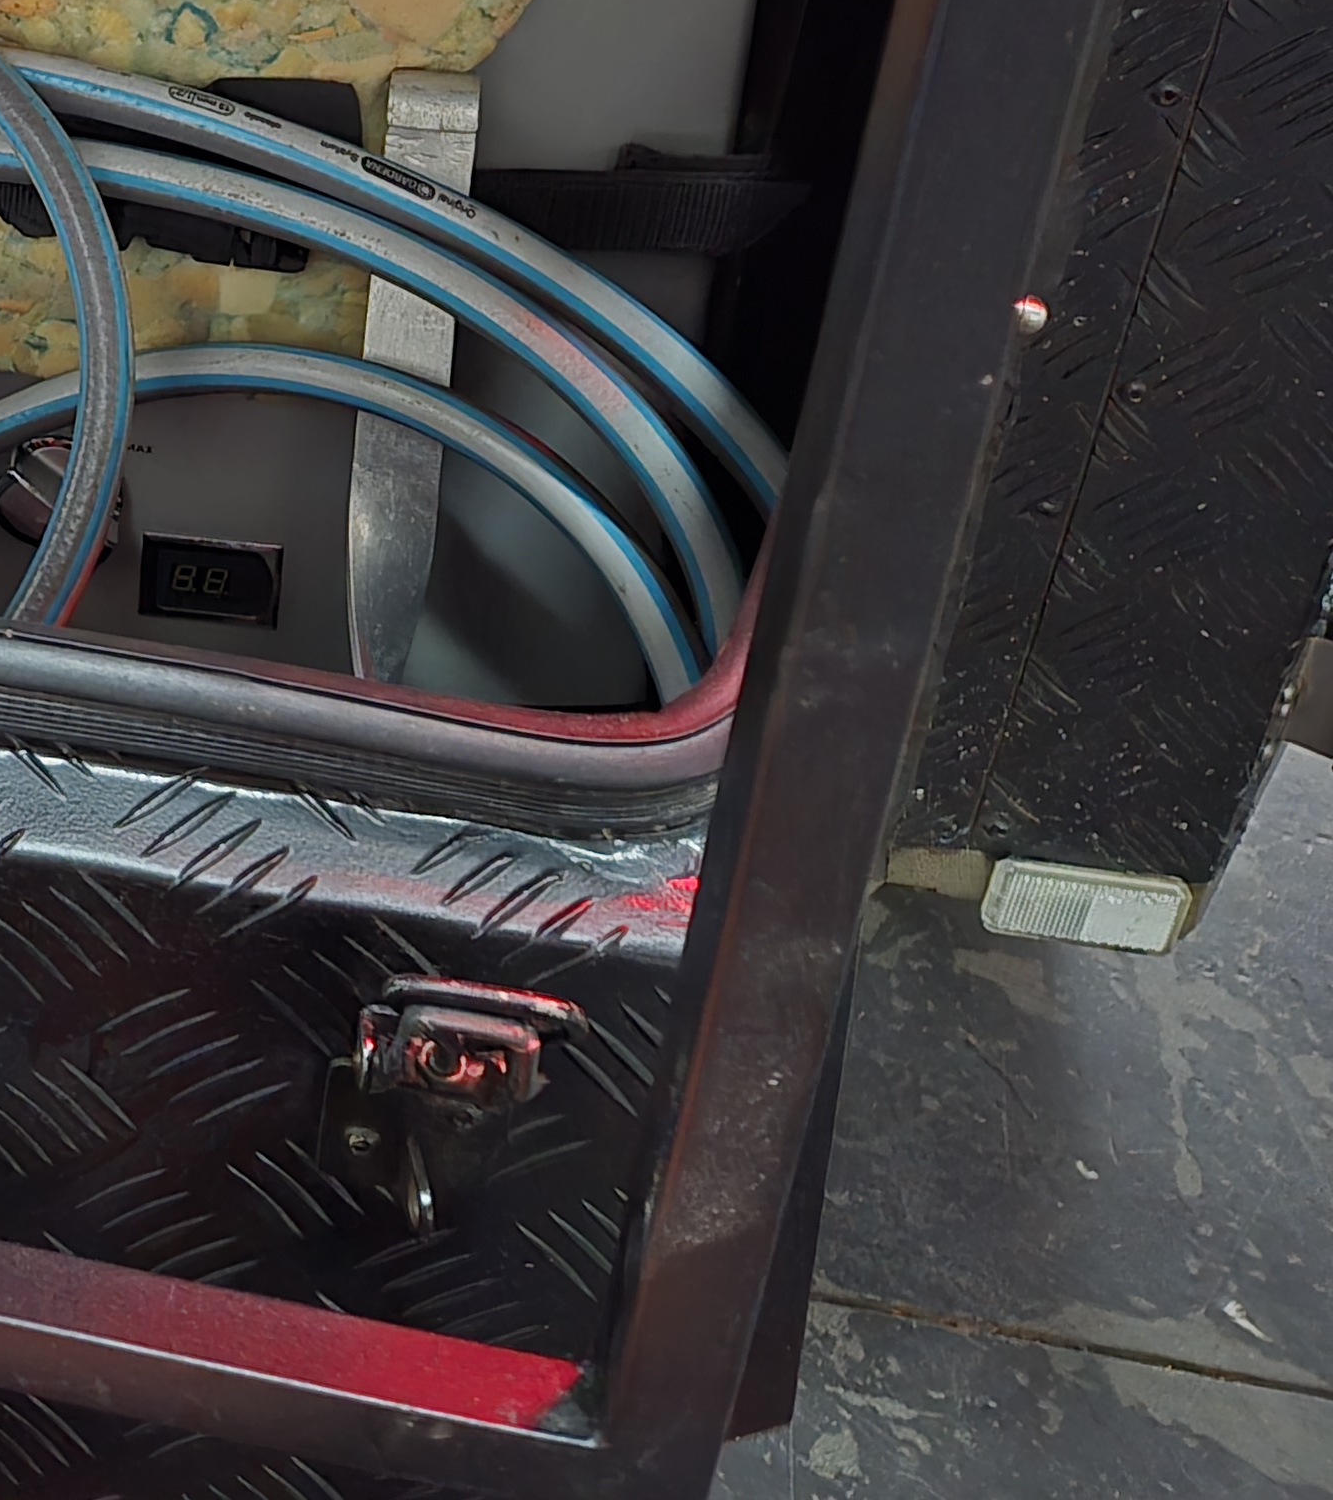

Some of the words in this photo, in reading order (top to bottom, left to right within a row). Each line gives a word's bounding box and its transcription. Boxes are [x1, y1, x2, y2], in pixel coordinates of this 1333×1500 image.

[320, 139, 360, 163] System
[364, 158, 418, 191] GARDENA
[437, 193, 477, 220] Original
